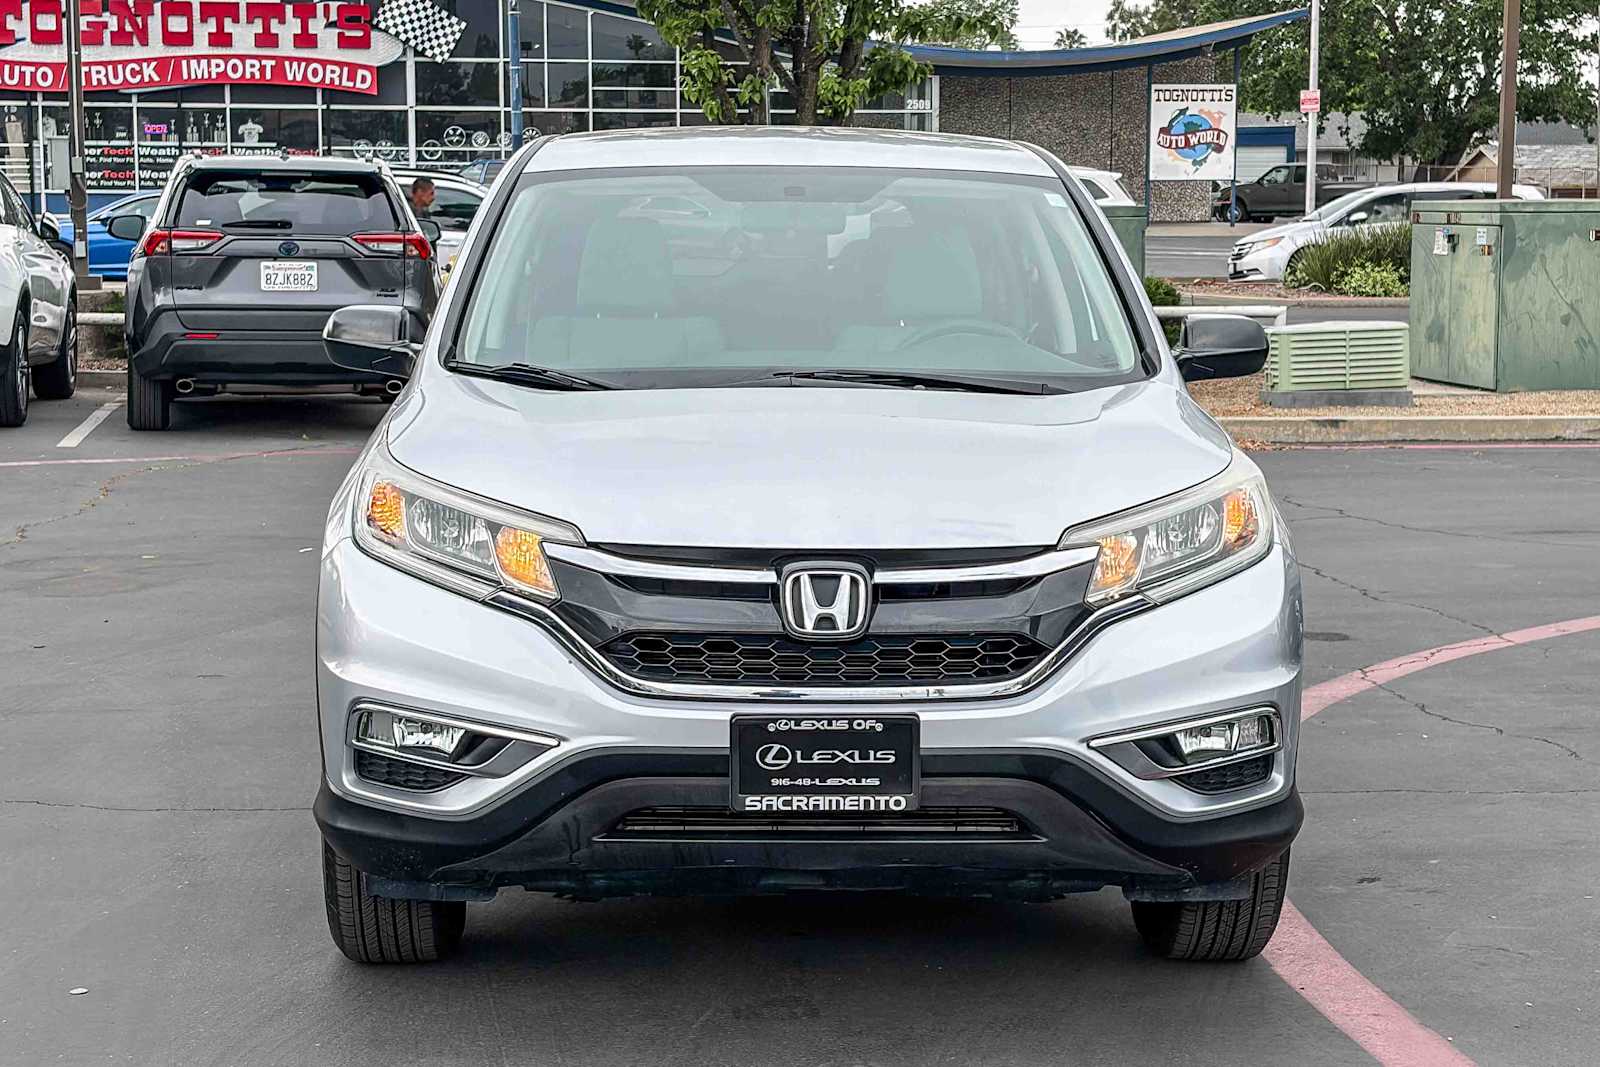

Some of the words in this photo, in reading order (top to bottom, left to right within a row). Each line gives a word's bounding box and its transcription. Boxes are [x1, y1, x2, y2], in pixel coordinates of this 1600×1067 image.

[0, 64, 53, 87] UTO
[181, 58, 276, 80] IMPORT
[284, 61, 372, 90] WORLD
[1154, 86, 1234, 102] TOGNOTTI'S
[906, 99, 931, 110] 2509
[144, 123, 168, 134] OPEN
[1157, 133, 1185, 149] AUTO
[1187, 130, 1228, 147] WORLD
[265, 272, 313, 286] 8ZJK882
[789, 719, 849, 731] LEXUS
[853, 719, 877, 731] OF
[795, 750, 896, 764] LEXUS
[745, 796, 907, 811] SACRAMENTO
